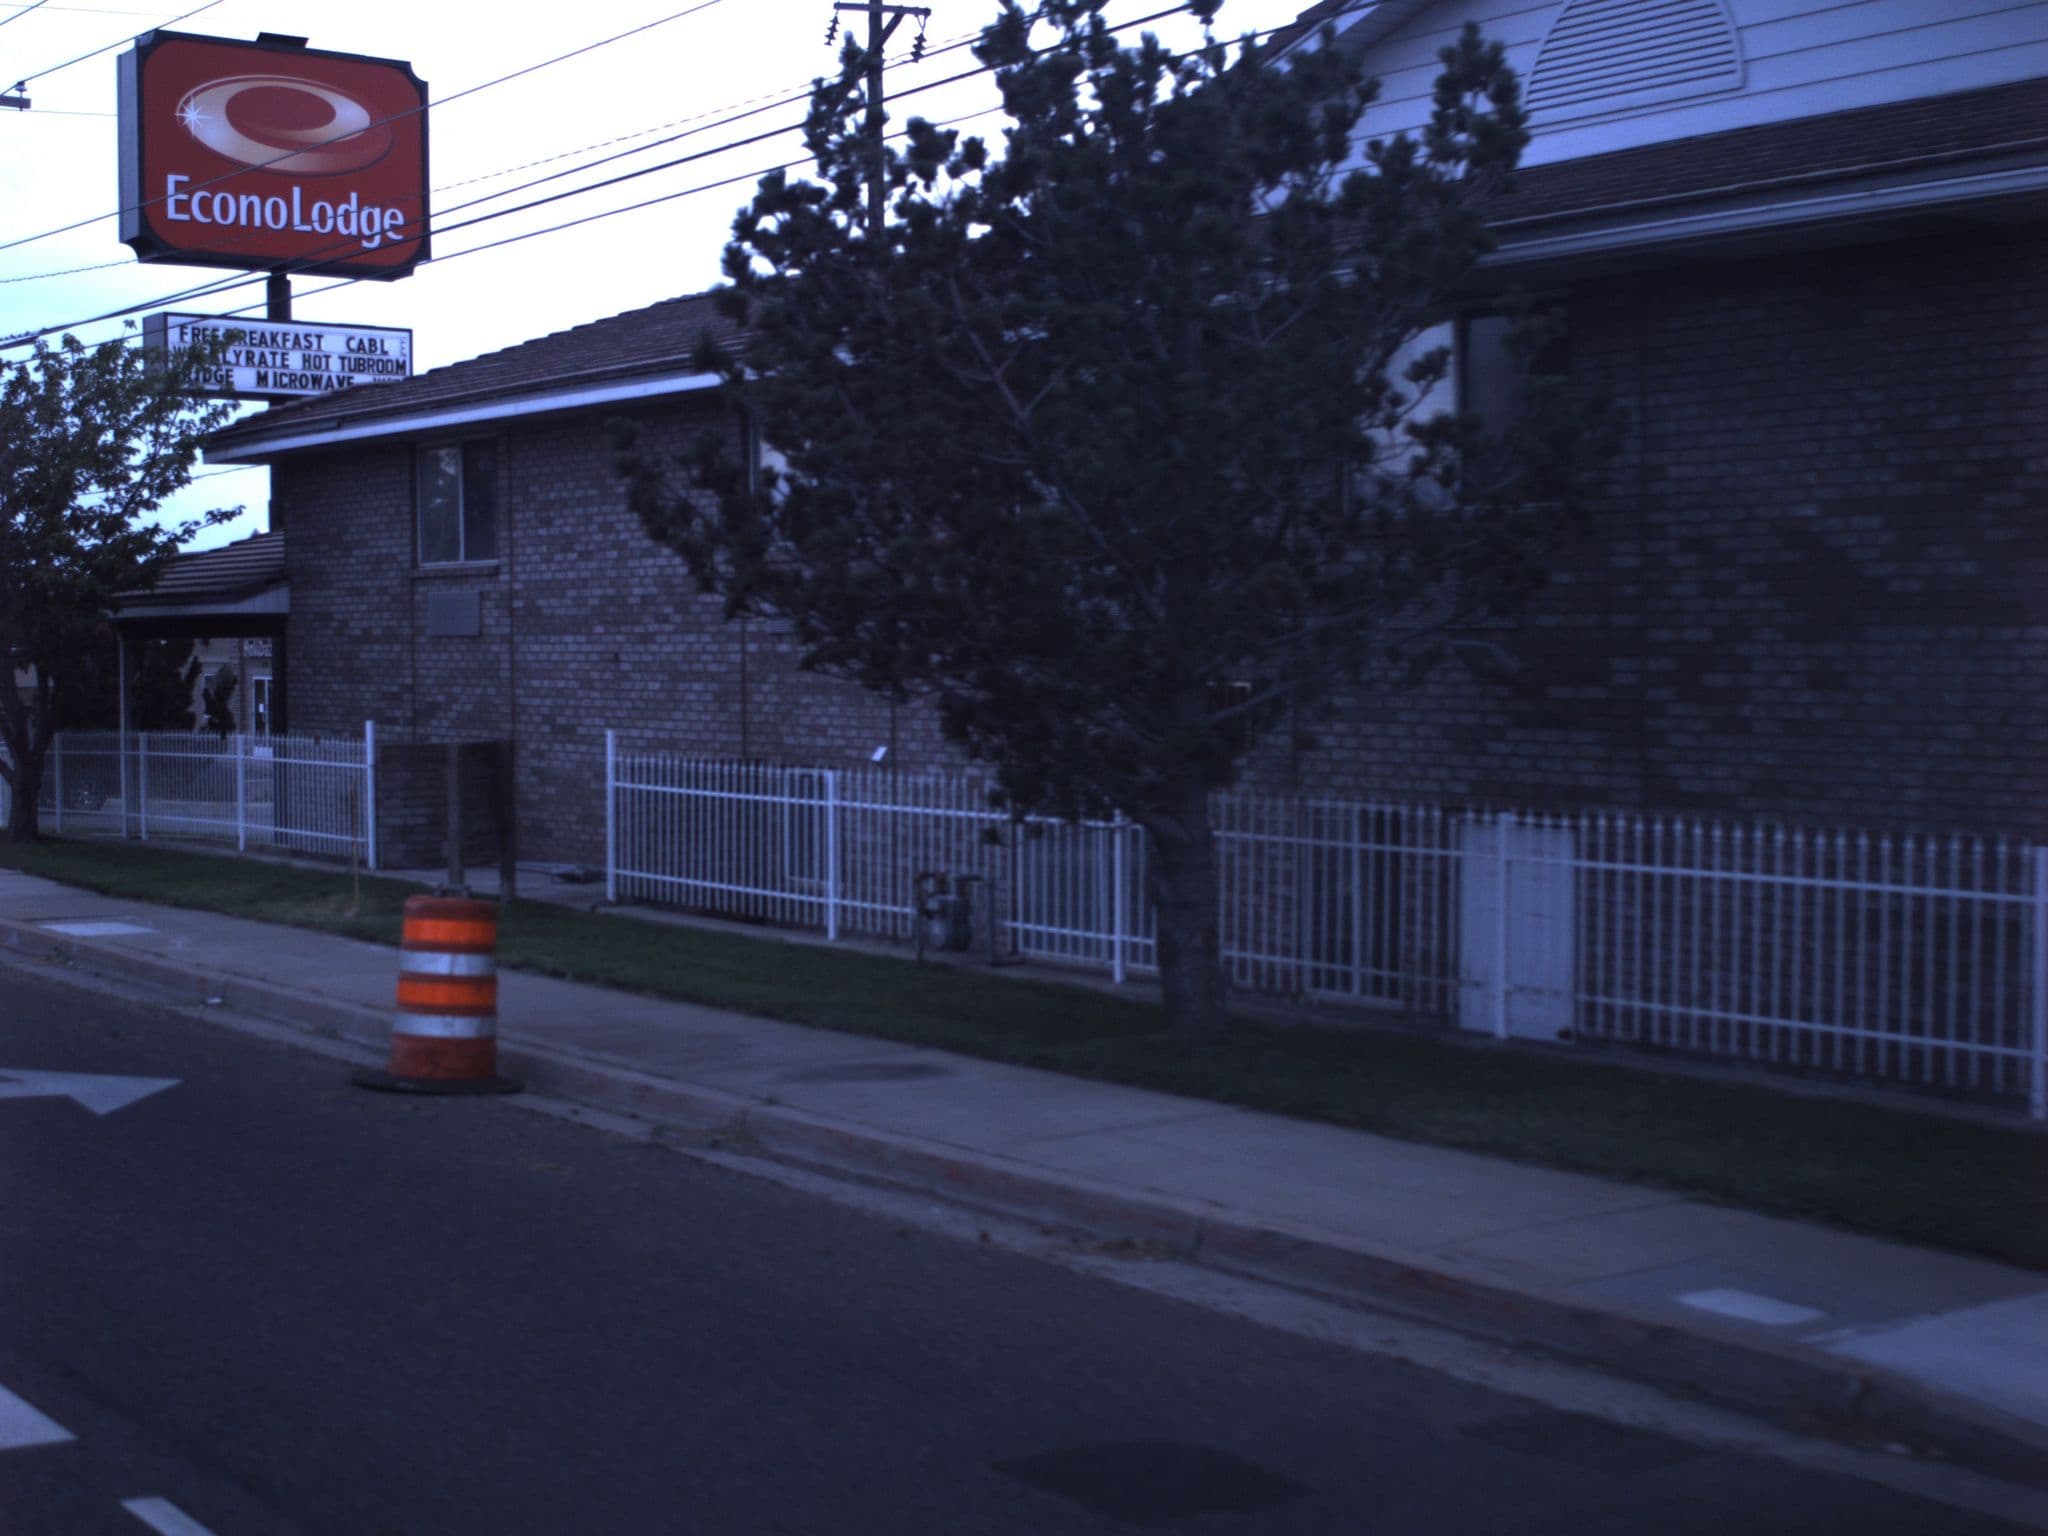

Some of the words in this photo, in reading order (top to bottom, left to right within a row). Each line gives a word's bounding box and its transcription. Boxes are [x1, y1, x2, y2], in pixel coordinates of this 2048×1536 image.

[166, 173, 404, 248] EconoLodge
[181, 325, 219, 345] FREE
[302, 352, 332, 371] HOT
[177, 365, 234, 385] RIDGE
[256, 370, 355, 391] MICROWAVE
